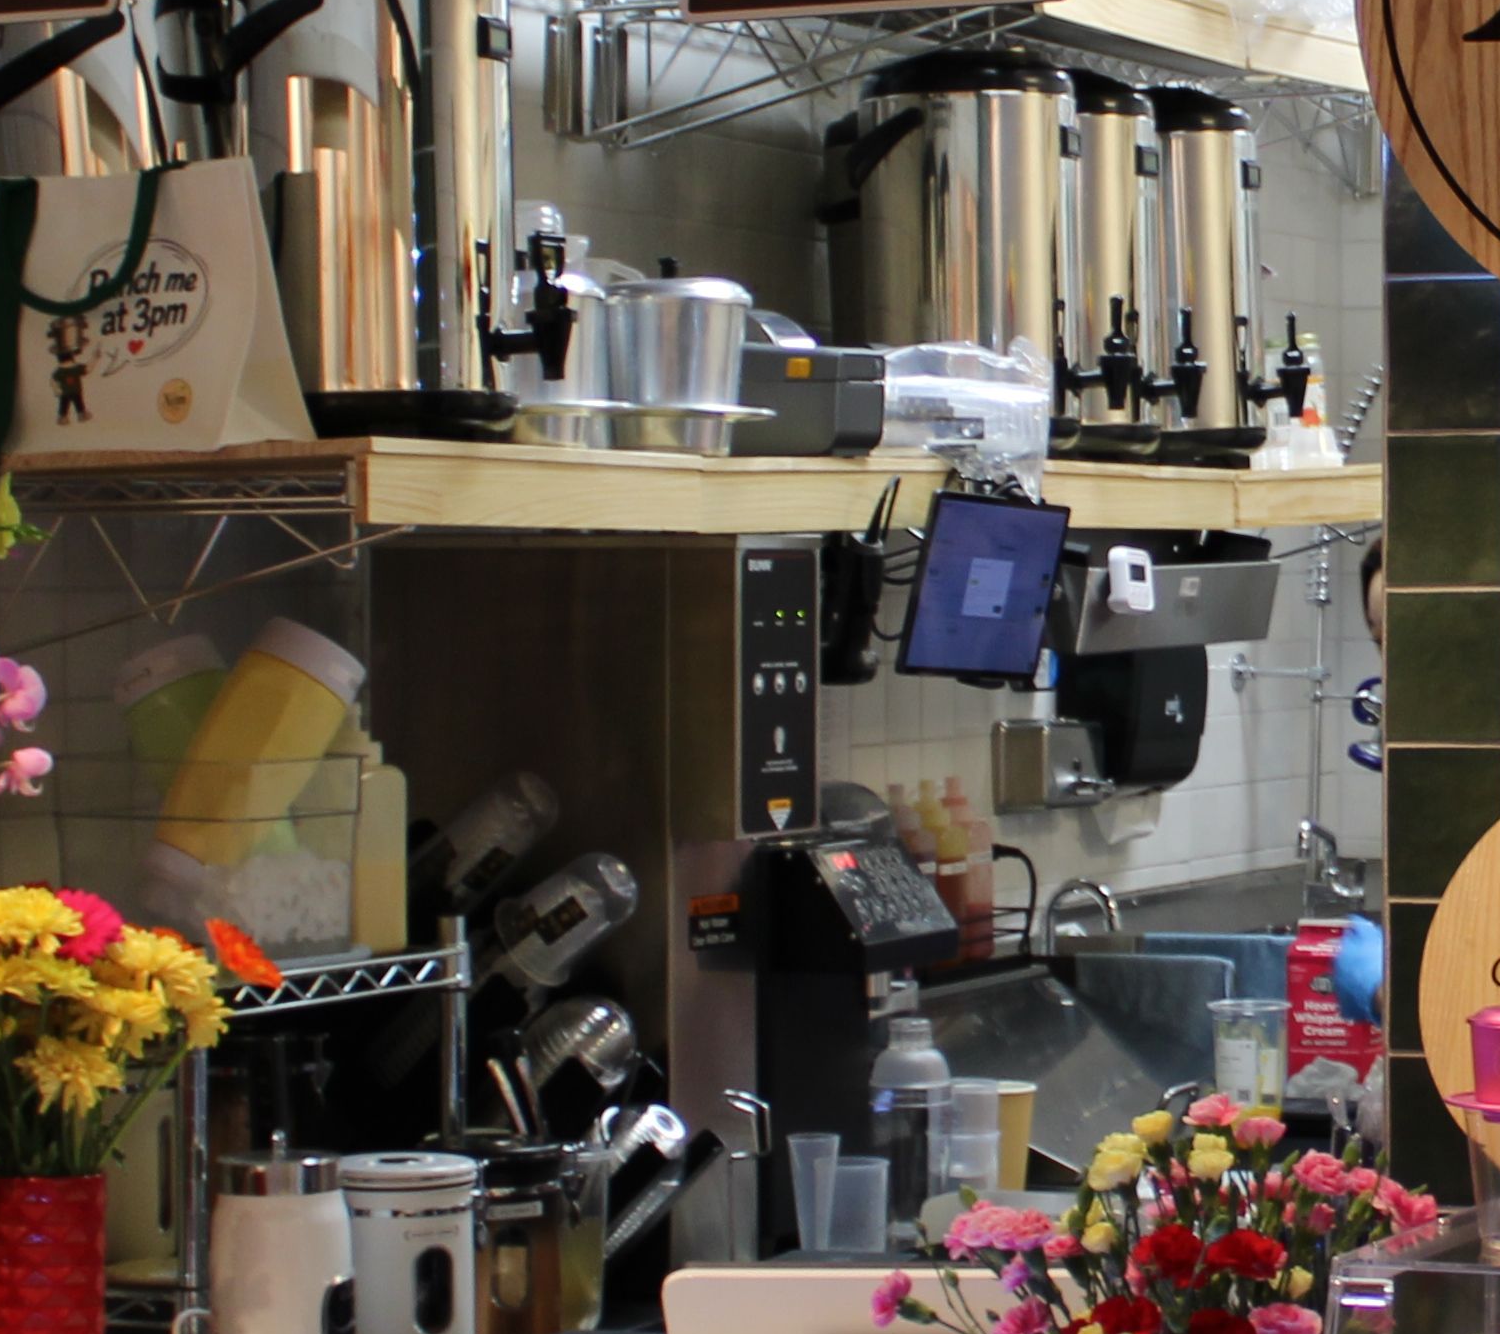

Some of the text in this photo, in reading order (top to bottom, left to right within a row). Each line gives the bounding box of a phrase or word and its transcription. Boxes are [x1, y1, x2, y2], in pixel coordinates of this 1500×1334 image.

[164, 272, 198, 293] me
[100, 298, 188, 338] at 3pm
